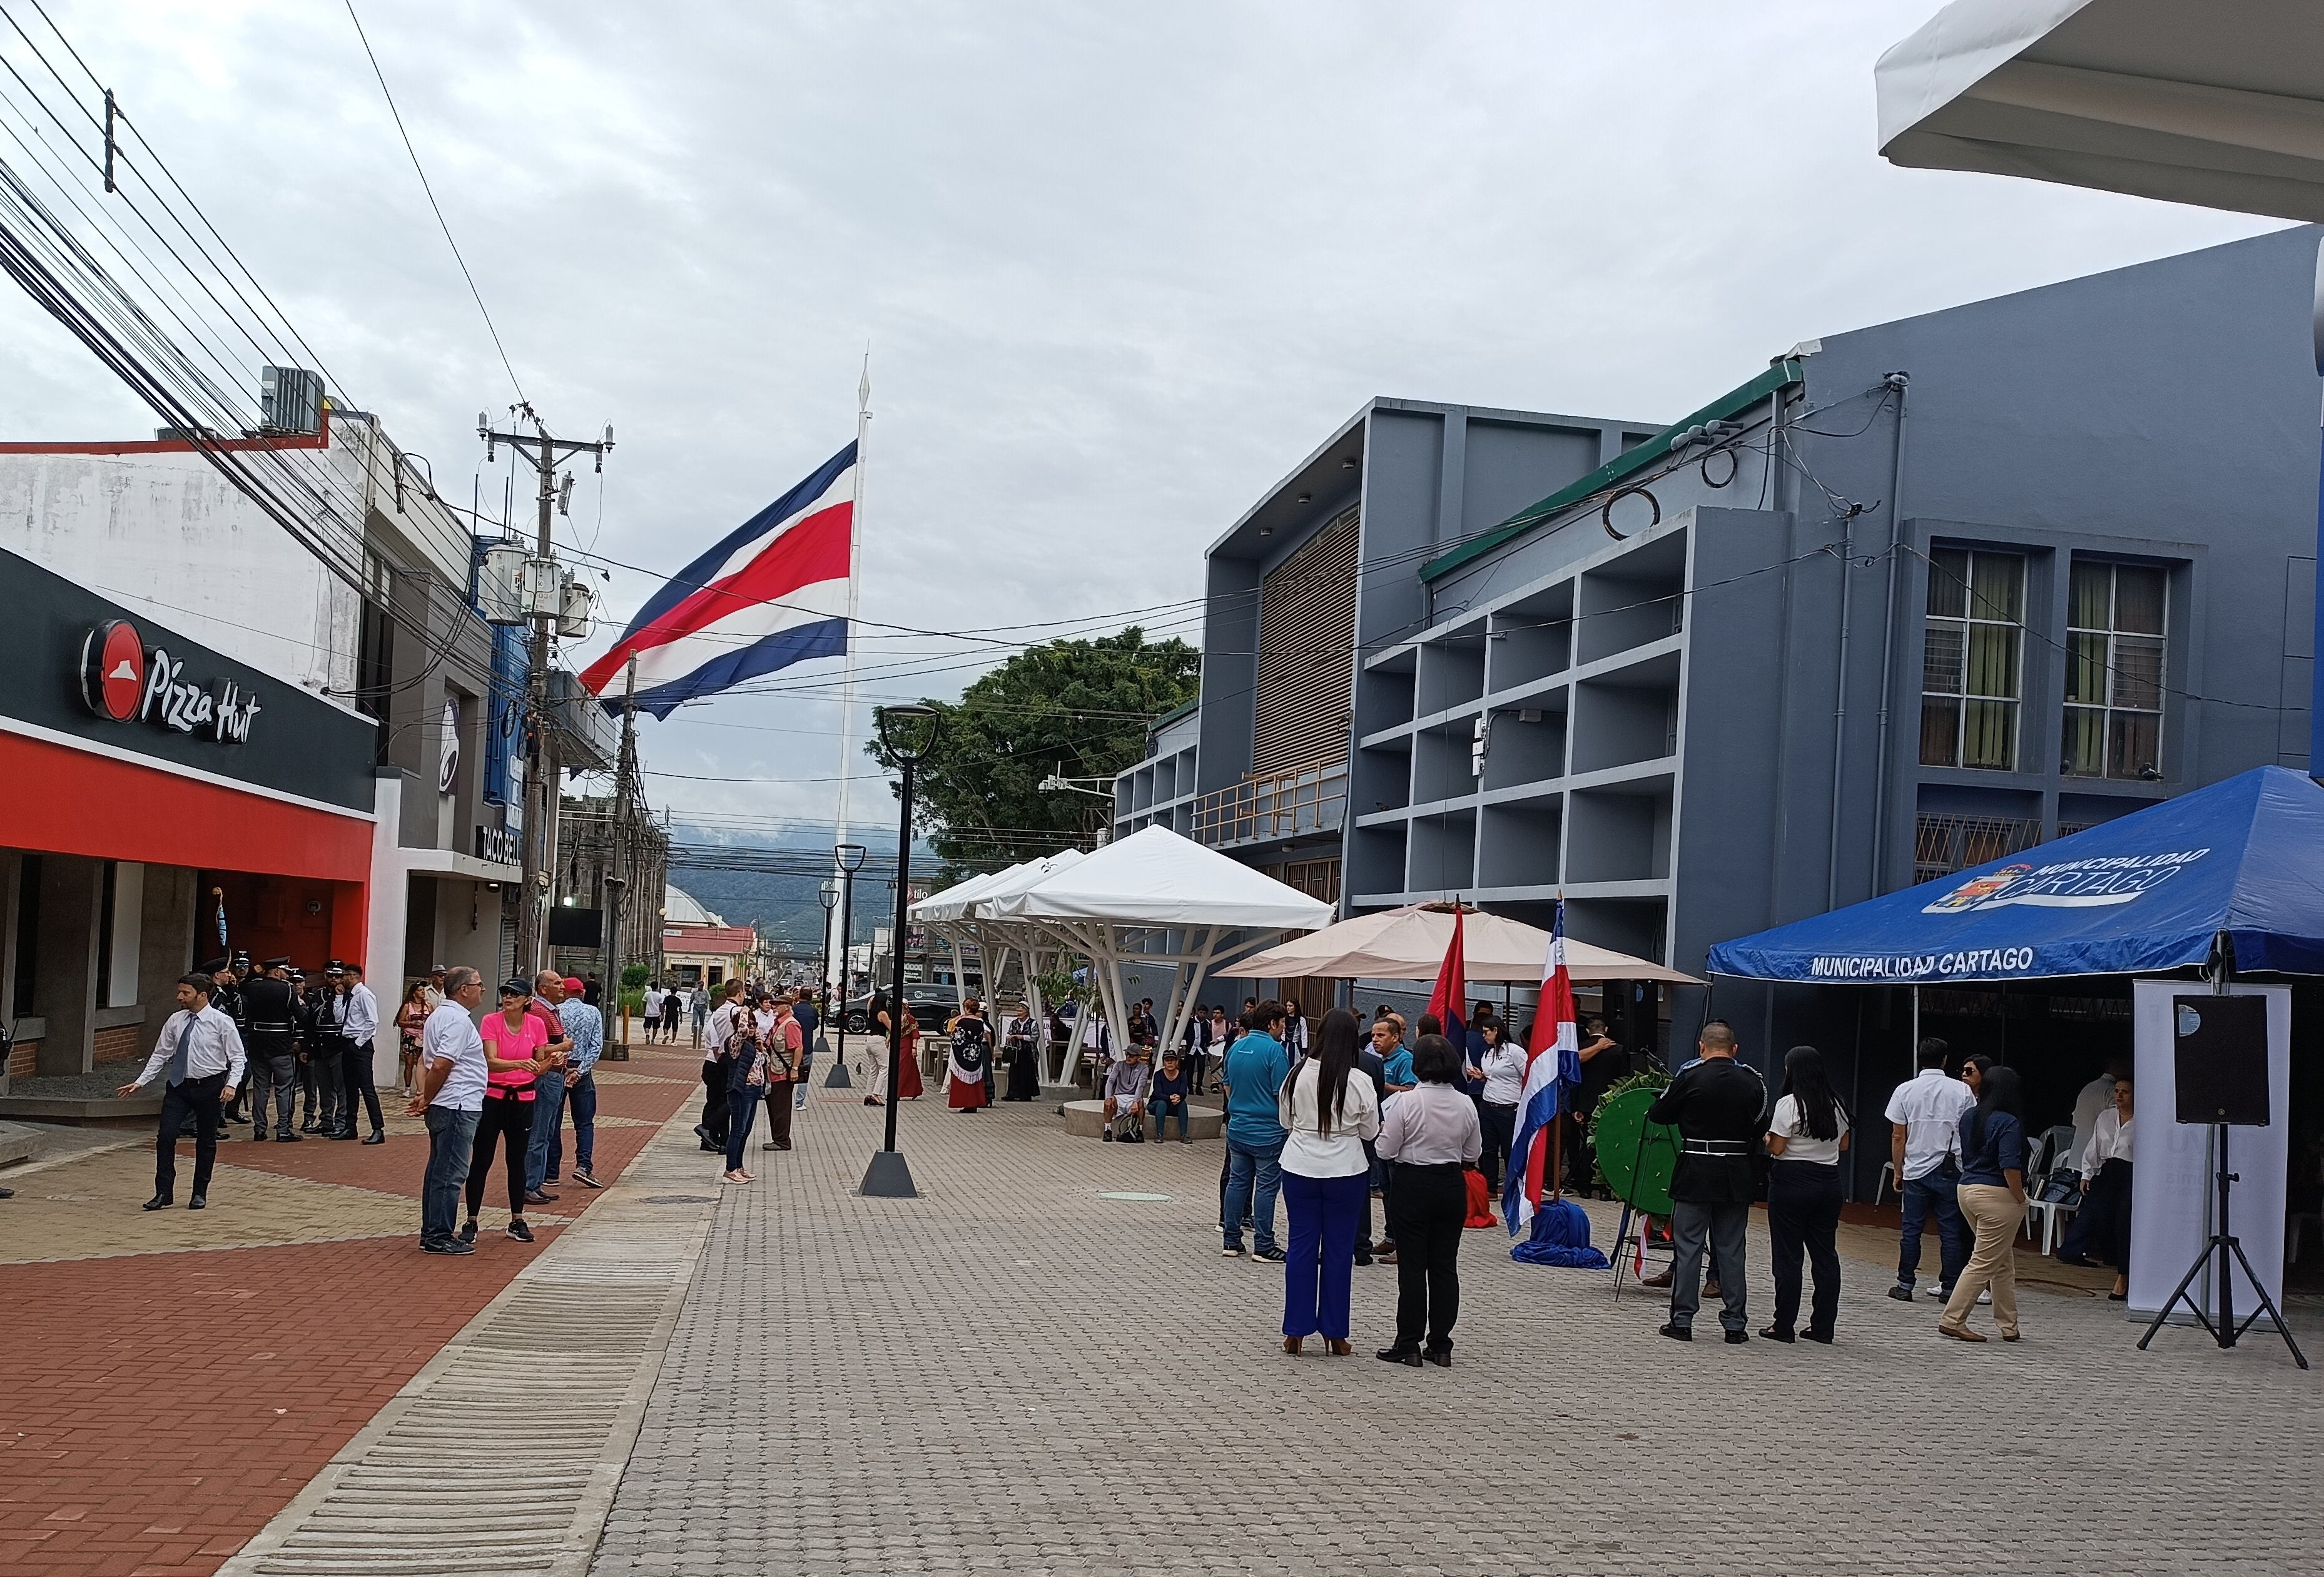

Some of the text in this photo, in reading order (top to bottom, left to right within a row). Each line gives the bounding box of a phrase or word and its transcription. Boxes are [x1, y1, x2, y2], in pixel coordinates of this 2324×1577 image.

[141, 649, 261, 743] Pizza Hut
[483, 826, 521, 866] TACO BELL
[2029, 847, 2211, 877] MUNICIPALIDAD
[1994, 865, 2181, 900] CARTAGO
[1810, 946, 2034, 978] MUNICIPALIDAD CARTAGO
